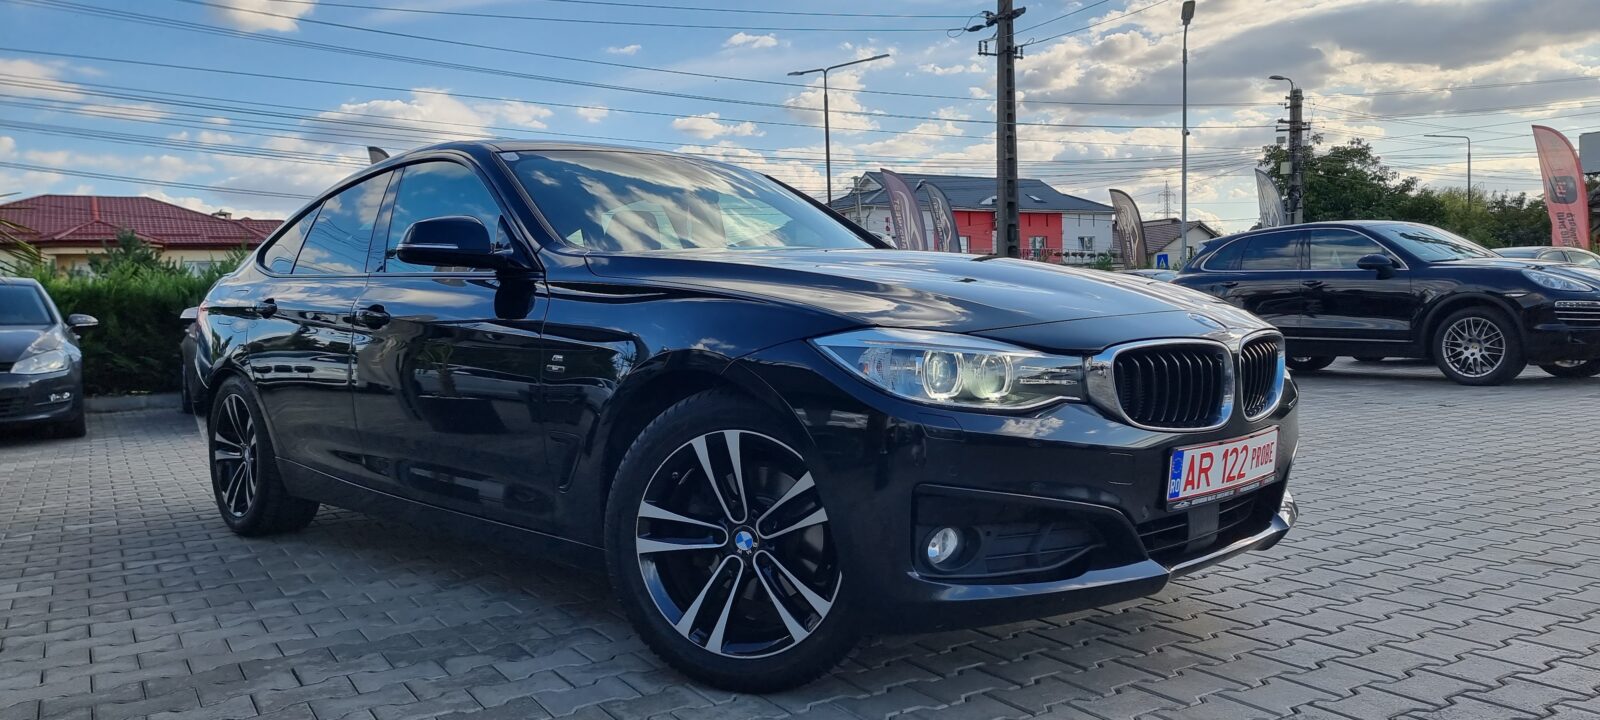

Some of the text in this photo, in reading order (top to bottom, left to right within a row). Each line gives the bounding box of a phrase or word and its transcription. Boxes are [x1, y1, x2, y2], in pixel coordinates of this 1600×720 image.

[1183, 452, 1214, 491] AR
[1221, 444, 1249, 484] 122
[1250, 442, 1275, 469] PROBE
[1170, 478, 1180, 494] RO
